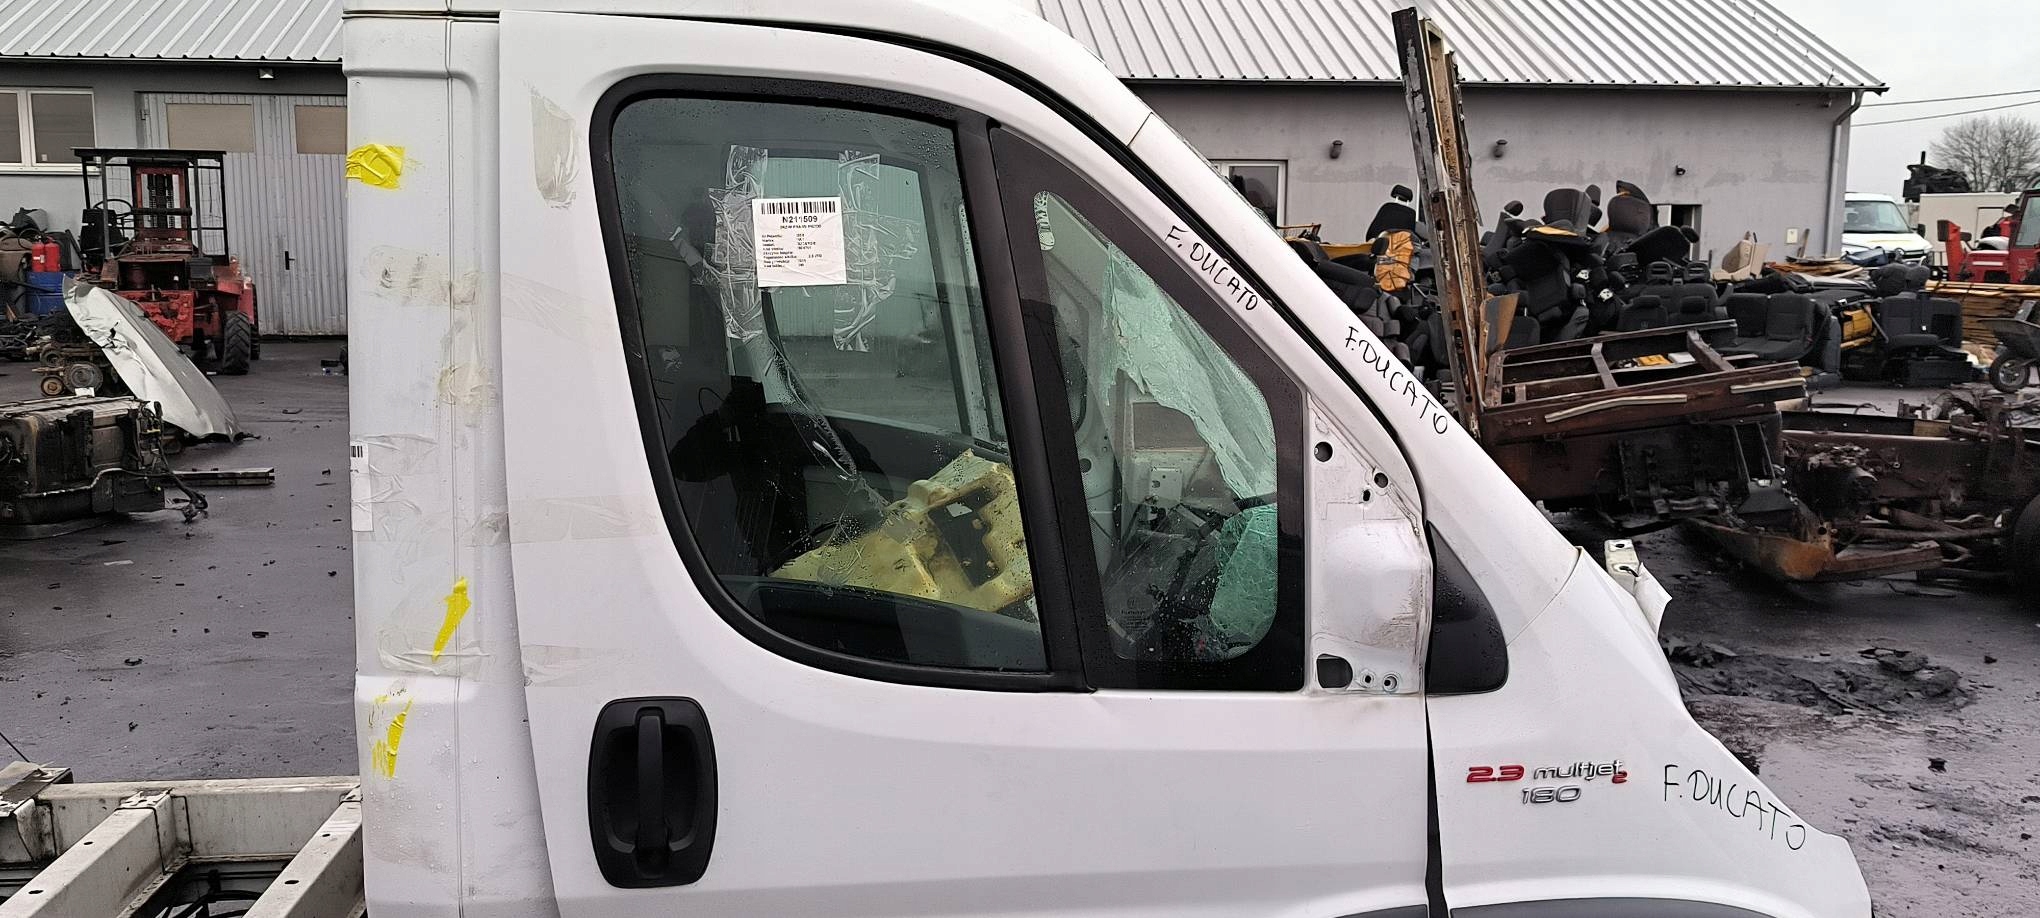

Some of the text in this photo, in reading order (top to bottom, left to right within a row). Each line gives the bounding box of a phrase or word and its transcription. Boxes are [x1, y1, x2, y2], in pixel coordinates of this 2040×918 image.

[1189, 243, 1258, 311] DUCATO
[1466, 764, 1525, 783] 2.3
[1521, 785, 1582, 805] 180
